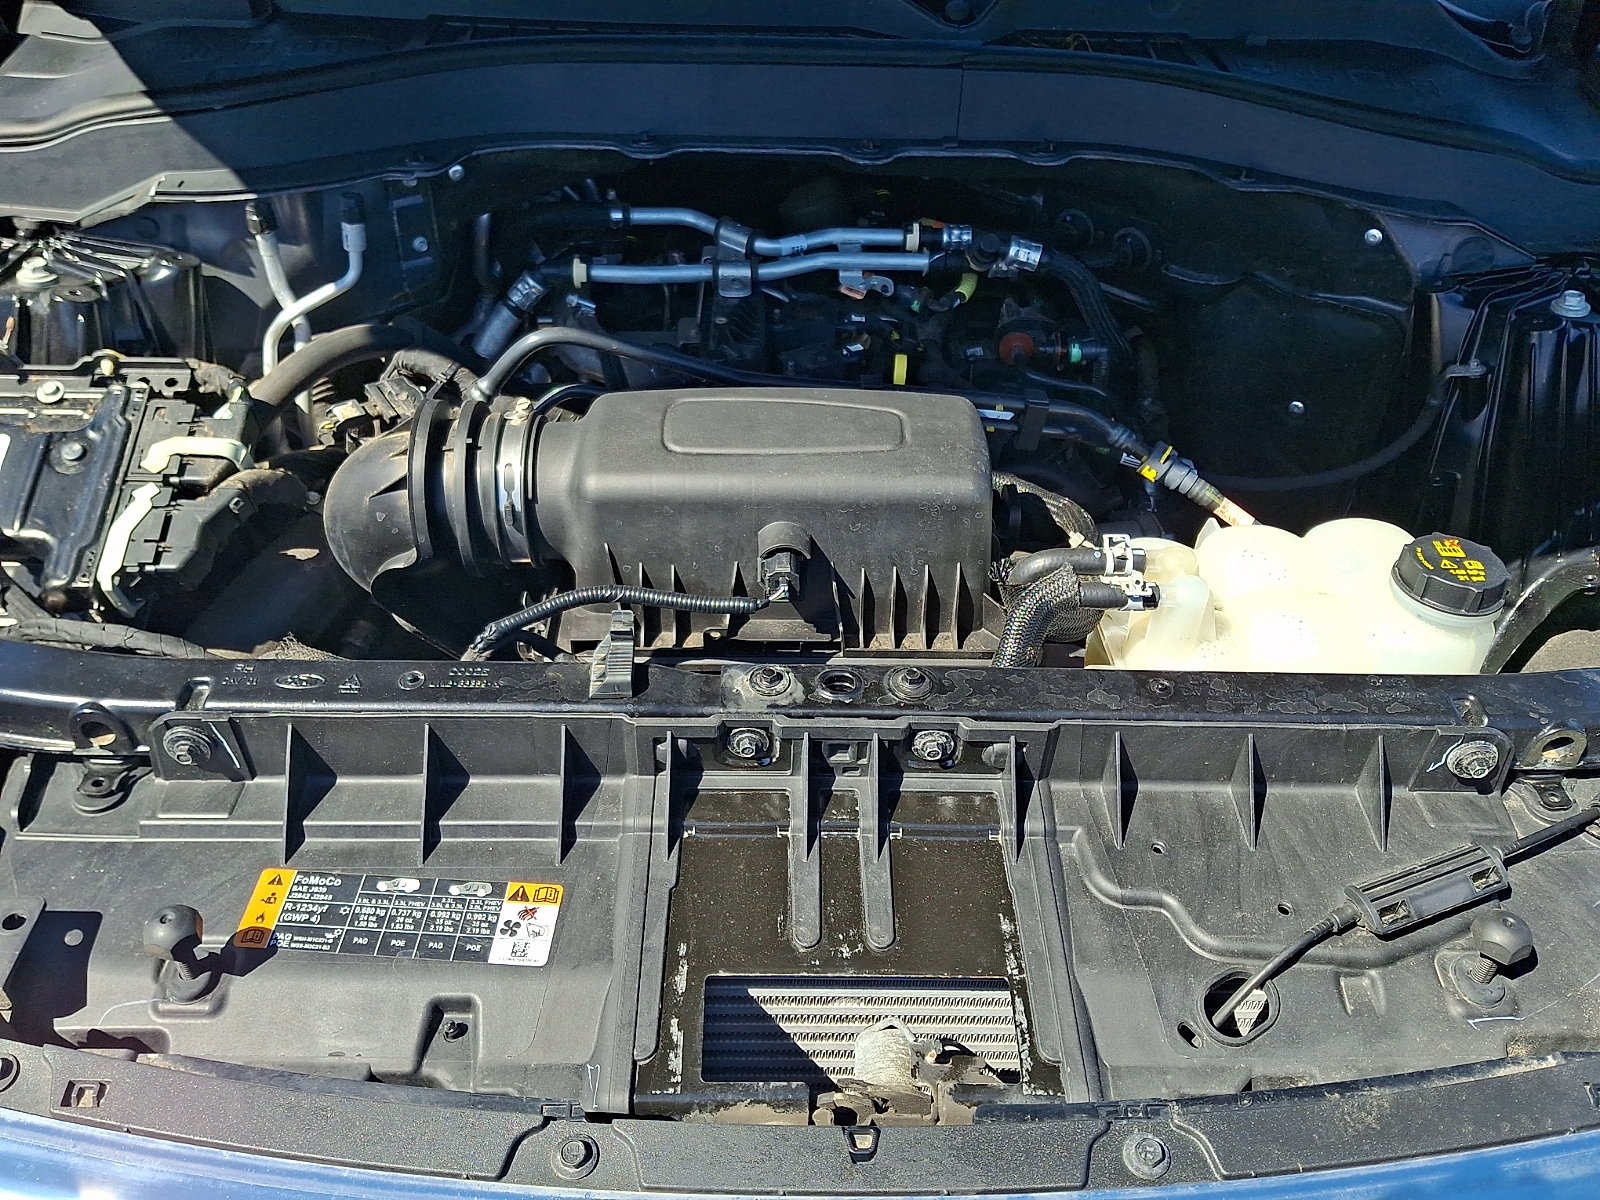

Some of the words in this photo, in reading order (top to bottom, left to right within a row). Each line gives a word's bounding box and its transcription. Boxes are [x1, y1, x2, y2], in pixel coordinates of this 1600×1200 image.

[294, 875, 342, 887] FoMoCo
[292, 885, 308, 893] SAE
[284, 902, 329, 914] R-1234yf
[354, 905, 375, 915] 0.680
[376, 906, 387, 917] kg
[280, 912, 310, 923] (GWP
[310, 914, 321, 924] 4)
[391, 908, 411, 917] 0.737
[412, 909, 423, 919] kg
[430, 910, 451, 919] 0.992
[452, 911, 462, 921] kg
[466, 912, 487, 921] 0.992
[488, 913, 498, 923] kg
[404, 923, 415, 931] lbs
[272, 932, 292, 941] PAG
[352, 937, 369, 945] PAG
[269, 939, 290, 948] POE
[390, 939, 407, 947] POE
[466, 944, 482, 952] POE
